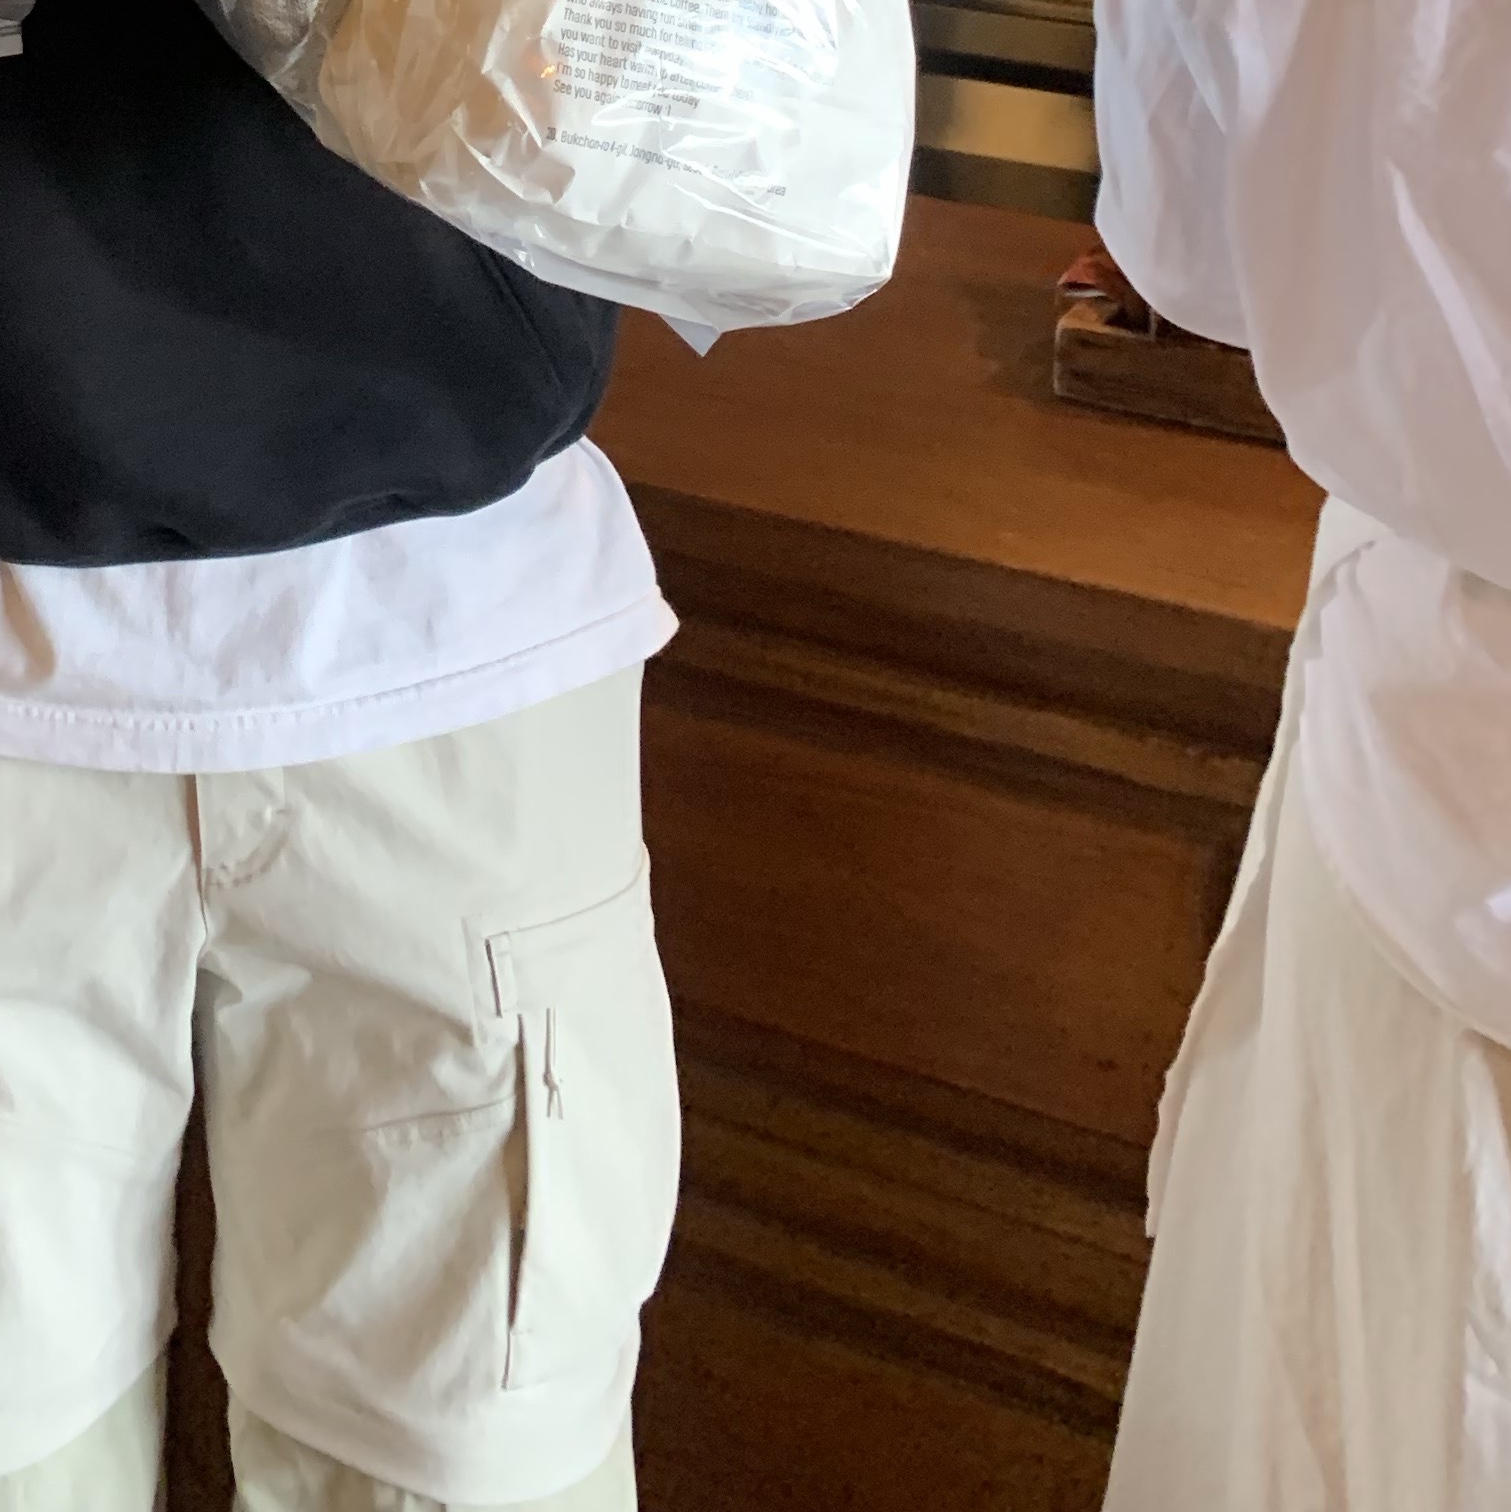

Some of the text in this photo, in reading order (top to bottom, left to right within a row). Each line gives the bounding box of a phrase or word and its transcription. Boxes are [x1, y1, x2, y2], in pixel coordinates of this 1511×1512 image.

[624, 2, 658, 24] having
[564, 8, 593, 26] Thank
[595, 15, 612, 31] you
[614, 20, 626, 33] so
[629, 22, 657, 40] much
[659, 29, 672, 43] for
[560, 28, 579, 44] you
[581, 33, 608, 46] want
[608, 37, 620, 50] to
[621, 40, 642, 55] visit
[558, 42, 575, 60] Has
[576, 48, 598, 66] your
[600, 52, 627, 71] heart
[553, 80, 572, 94] See
[574, 84, 592, 100] you
[574, 68, 586, 81] so
[588, 70, 618, 90] happy
